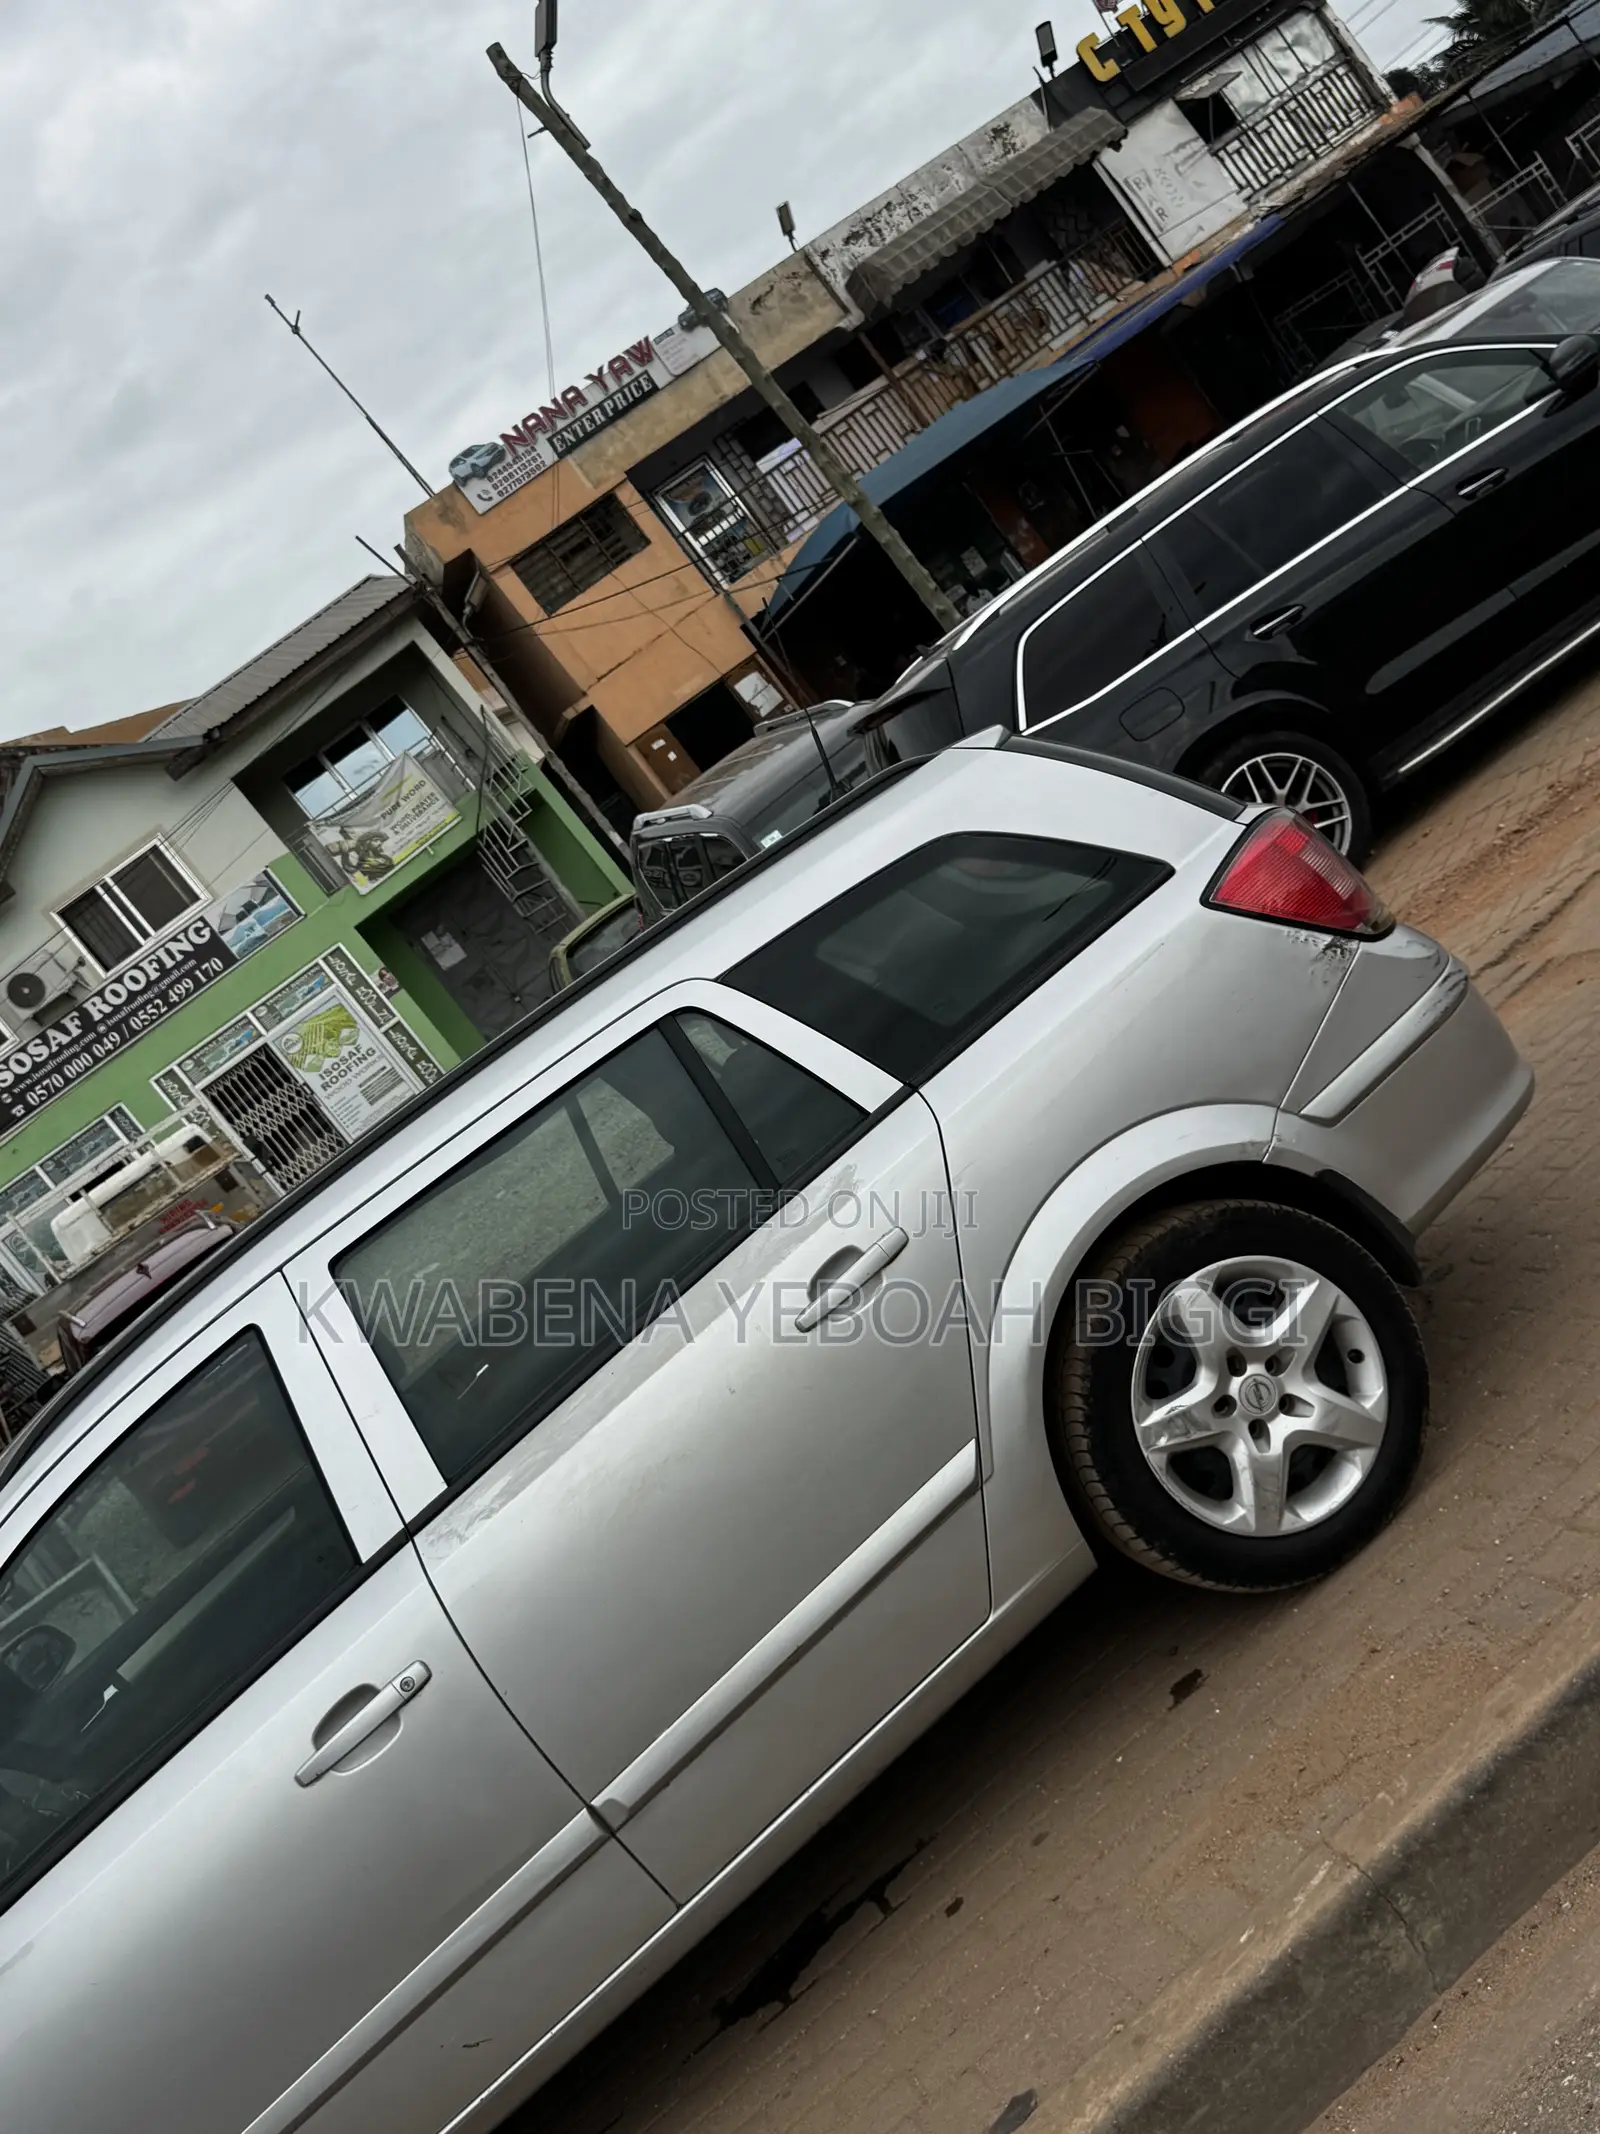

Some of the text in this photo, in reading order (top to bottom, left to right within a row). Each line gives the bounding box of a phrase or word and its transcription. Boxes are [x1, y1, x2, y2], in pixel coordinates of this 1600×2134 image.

[500, 385, 589, 457] NANA
[584, 336, 655, 393] YAW
[552, 372, 654, 453] ENTERPRICE
[381, 801, 401, 820] PURE
[401, 780, 426, 802] WORD
[82, 921, 211, 1021] ROOFING
[26, 1073, 65, 1106] 0570
[63, 1052, 94, 1079] 000
[92, 1031, 121, 1058] 049
[129, 998, 168, 1031] 0552
[168, 977, 194, 1003] 499
[194, 956, 224, 983] 170
[319, 1044, 363, 1081] ISOSAF
[320, 1047, 377, 1091] ROOFING
